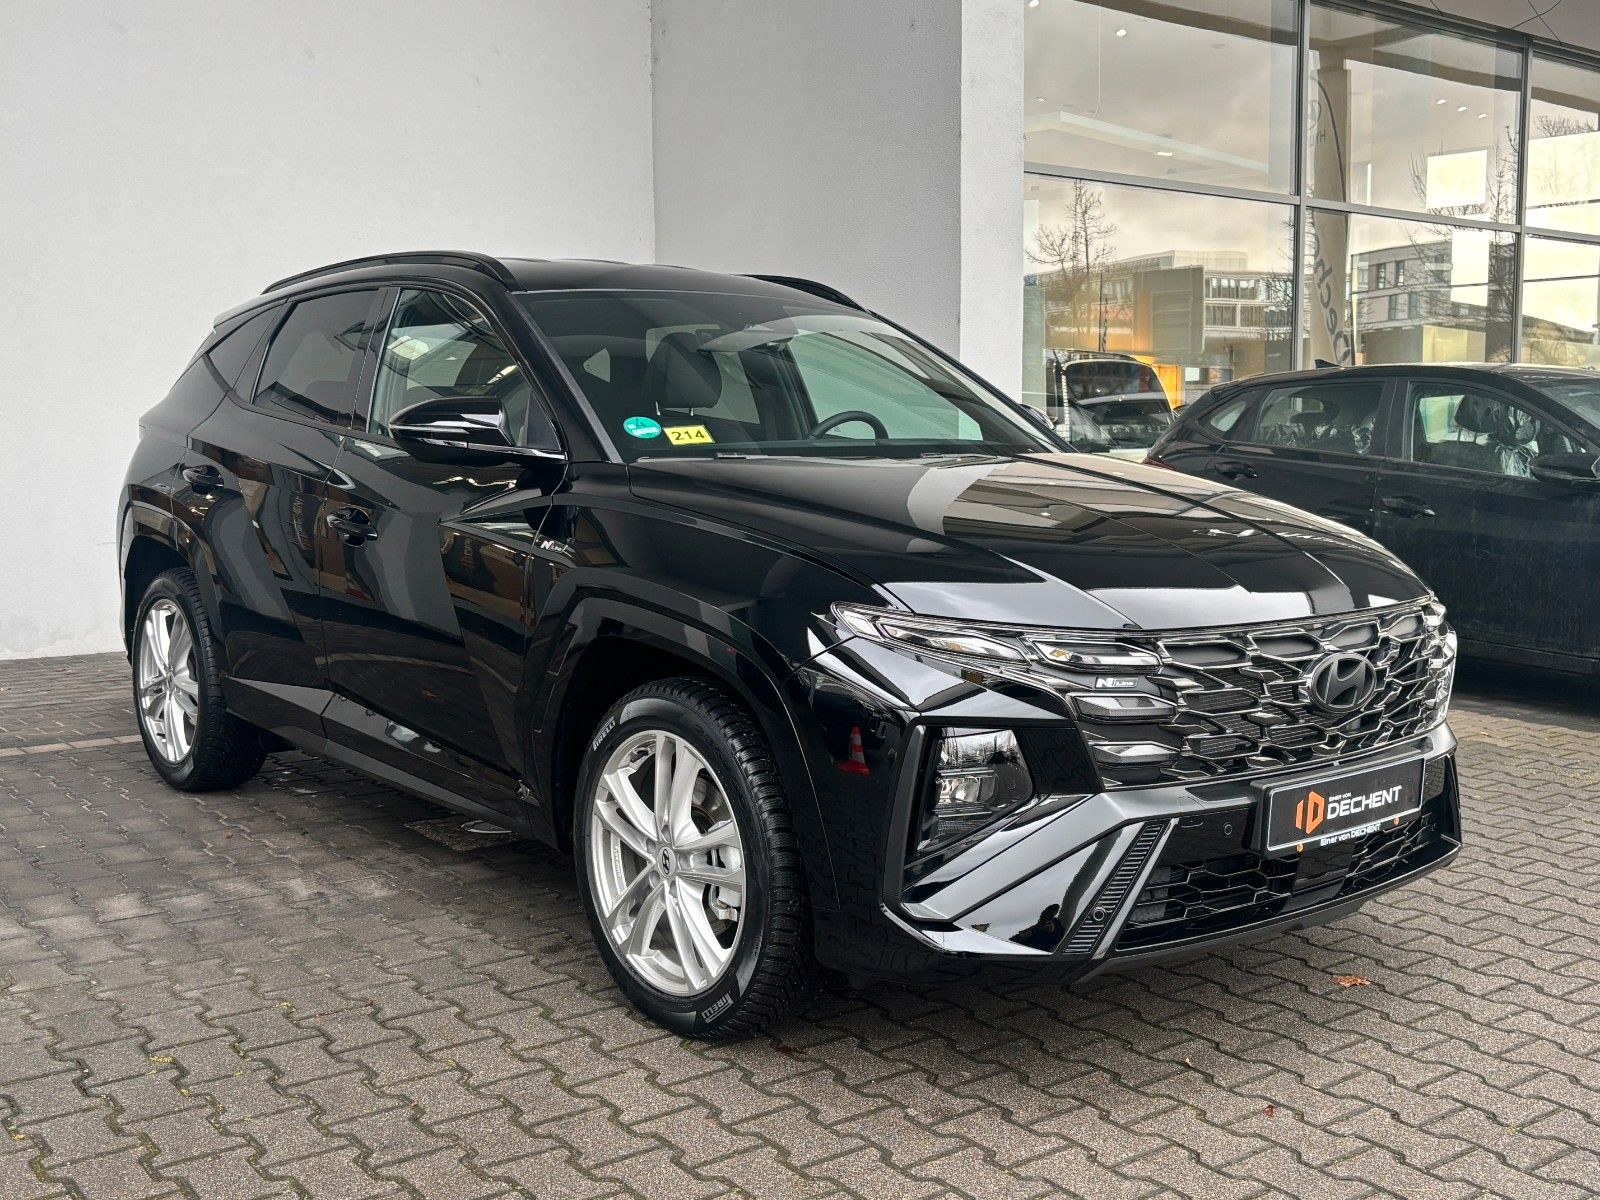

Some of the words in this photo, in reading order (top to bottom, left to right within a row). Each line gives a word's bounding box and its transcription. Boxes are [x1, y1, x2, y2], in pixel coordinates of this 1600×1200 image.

[671, 430, 705, 441] 214
[592, 716, 615, 752] PIRELLI
[1326, 785, 1402, 820] DECHENT
[1338, 832, 1350, 842] von
[1350, 823, 1381, 839] DECHENT
[701, 991, 734, 1024] PIRELLI
